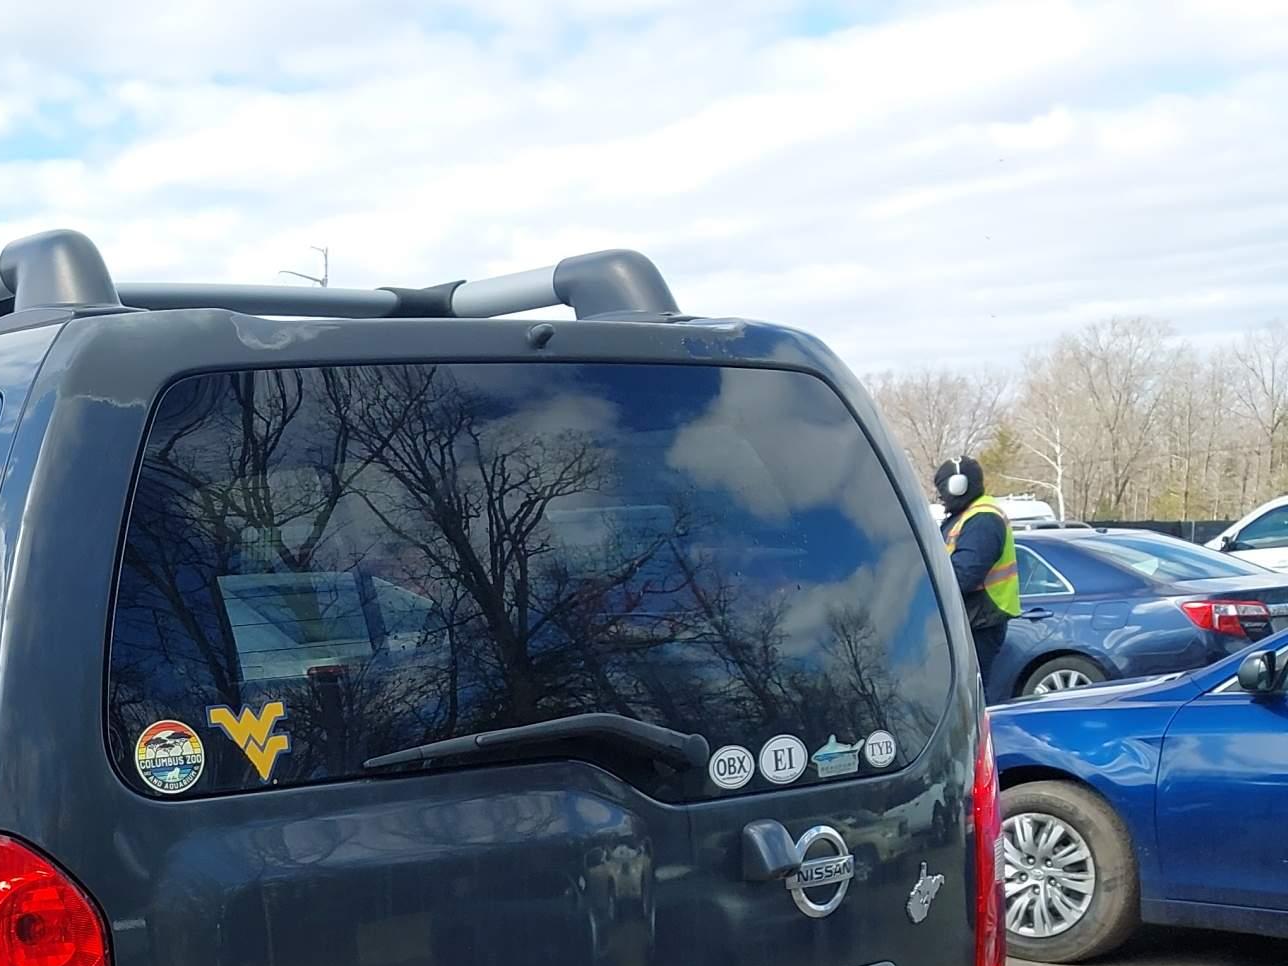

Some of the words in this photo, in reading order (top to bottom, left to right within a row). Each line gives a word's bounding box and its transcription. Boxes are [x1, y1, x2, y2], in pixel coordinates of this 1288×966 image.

[868, 740, 893, 757] TYB
[139, 755, 185, 769] COLUMBUS
[185, 754, 202, 765] ZOO
[716, 755, 748, 777] OBX
[772, 746, 796, 773] EI
[148, 775, 163, 787] AND
[163, 770, 198, 790] AQUARIUM
[796, 859, 852, 884] NISSAN
